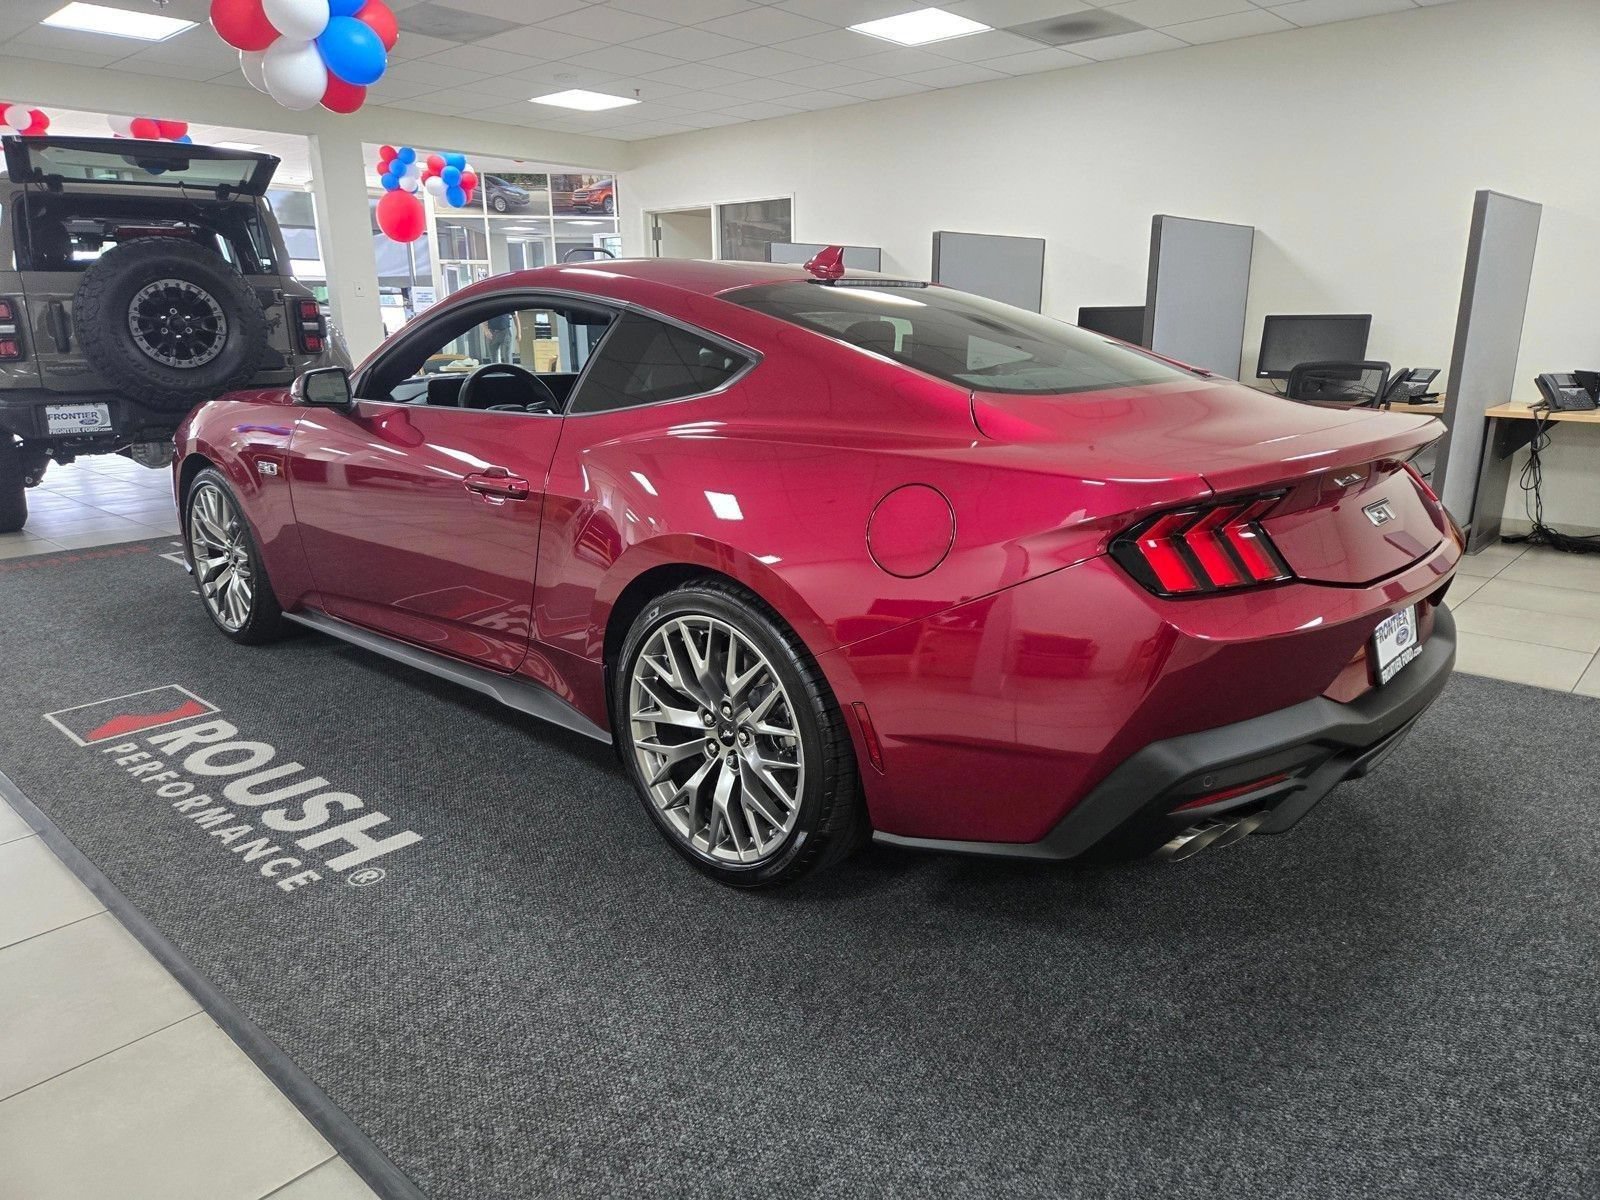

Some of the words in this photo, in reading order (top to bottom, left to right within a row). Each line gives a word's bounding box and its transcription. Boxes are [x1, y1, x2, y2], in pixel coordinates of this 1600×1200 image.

[47, 411, 100, 420] FRONTIER
[1361, 497, 1397, 527] GT
[103, 742, 323, 892] PERFORMANCE
[147, 719, 423, 872] ROUSH
